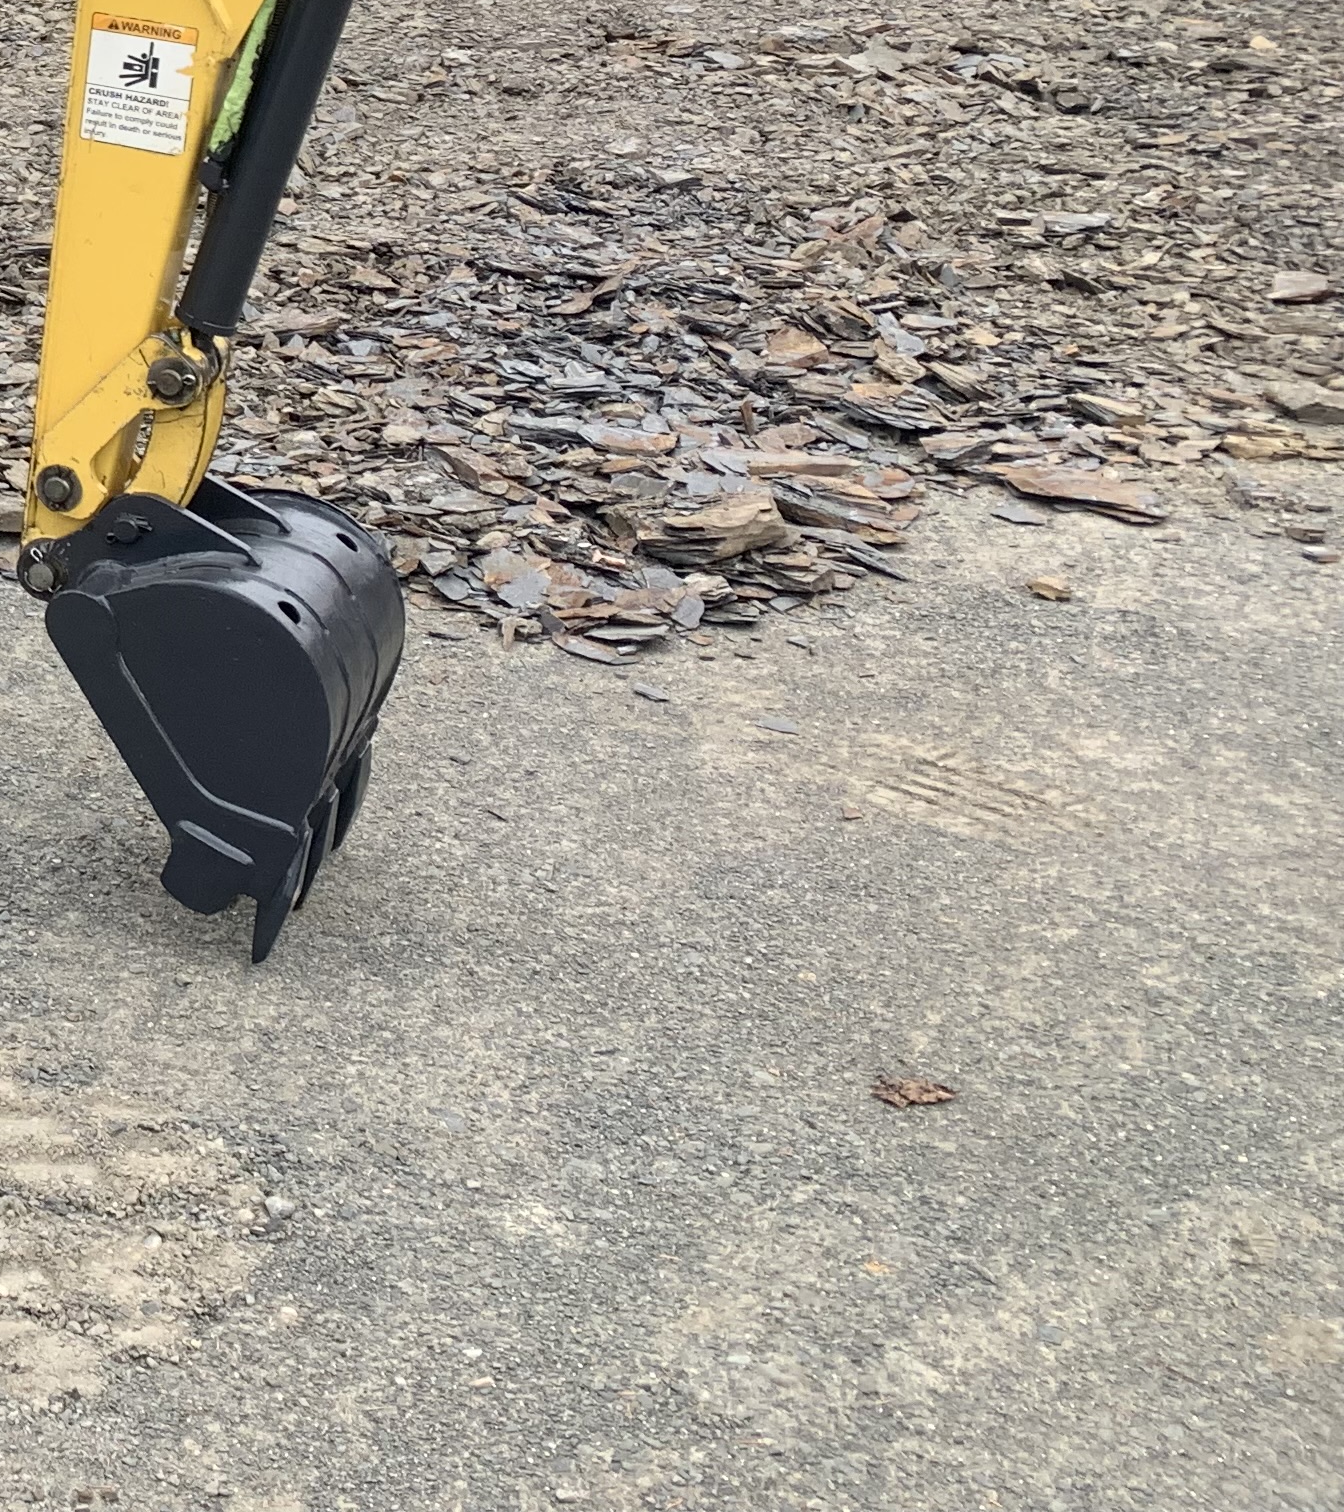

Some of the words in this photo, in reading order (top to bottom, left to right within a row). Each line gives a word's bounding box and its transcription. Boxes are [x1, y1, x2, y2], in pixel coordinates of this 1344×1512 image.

[121, 20, 182, 40] WARNING
[88, 87, 123, 100] CRUSH
[87, 97, 110, 109] STAY
[112, 101, 140, 112] CLEAR
[142, 107, 153, 115] OF
[85, 117, 107, 128] result
[108, 121, 117, 129] in
[118, 123, 141, 133] death
[86, 107, 113, 118] Failure
[115, 112, 123, 120] to
[124, 115, 153, 126] comply
[155, 120, 179, 130] could
